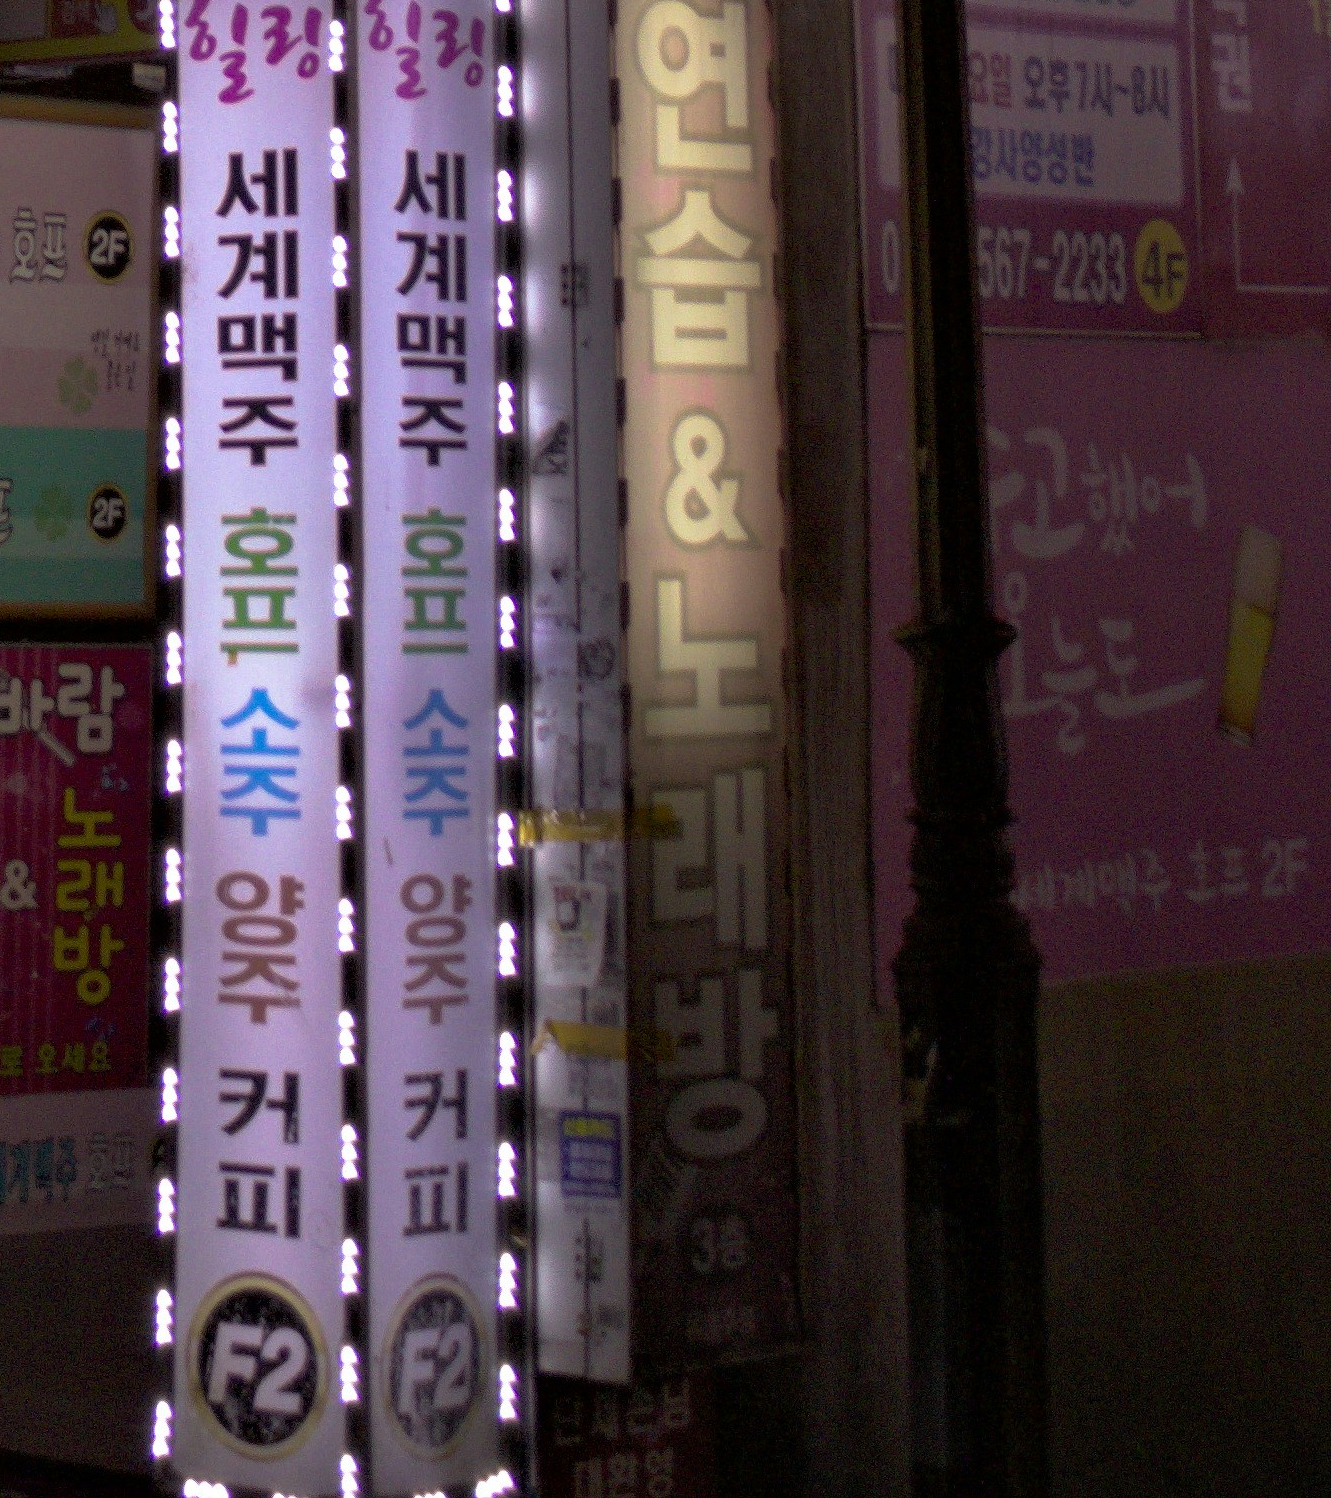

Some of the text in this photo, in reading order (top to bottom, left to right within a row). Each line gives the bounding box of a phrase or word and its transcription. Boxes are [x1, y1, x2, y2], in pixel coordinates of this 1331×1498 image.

[9, 206, 68, 283] 호프
[89, 229, 128, 267] 2F
[1139, 239, 1185, 299] 4F
[216, 147, 300, 655] 세계맥주 호프
[394, 149, 469, 655] 세계맥주 호프
[91, 498, 125, 531] 2F
[663, 412, 761, 549] &
[52, 784, 127, 1006] 노래방
[644, 575, 780, 1160] 노래방
[1261, 837, 1309, 900] 2F
[214, 687, 306, 1240] 소주 양주 커피
[398, 687, 473, 1238] 소주 양주 커피
[36, 1038, 114, 1076] 오세요
[210, 1322, 309, 1416] F2
[397, 1324, 473, 1418] F2
